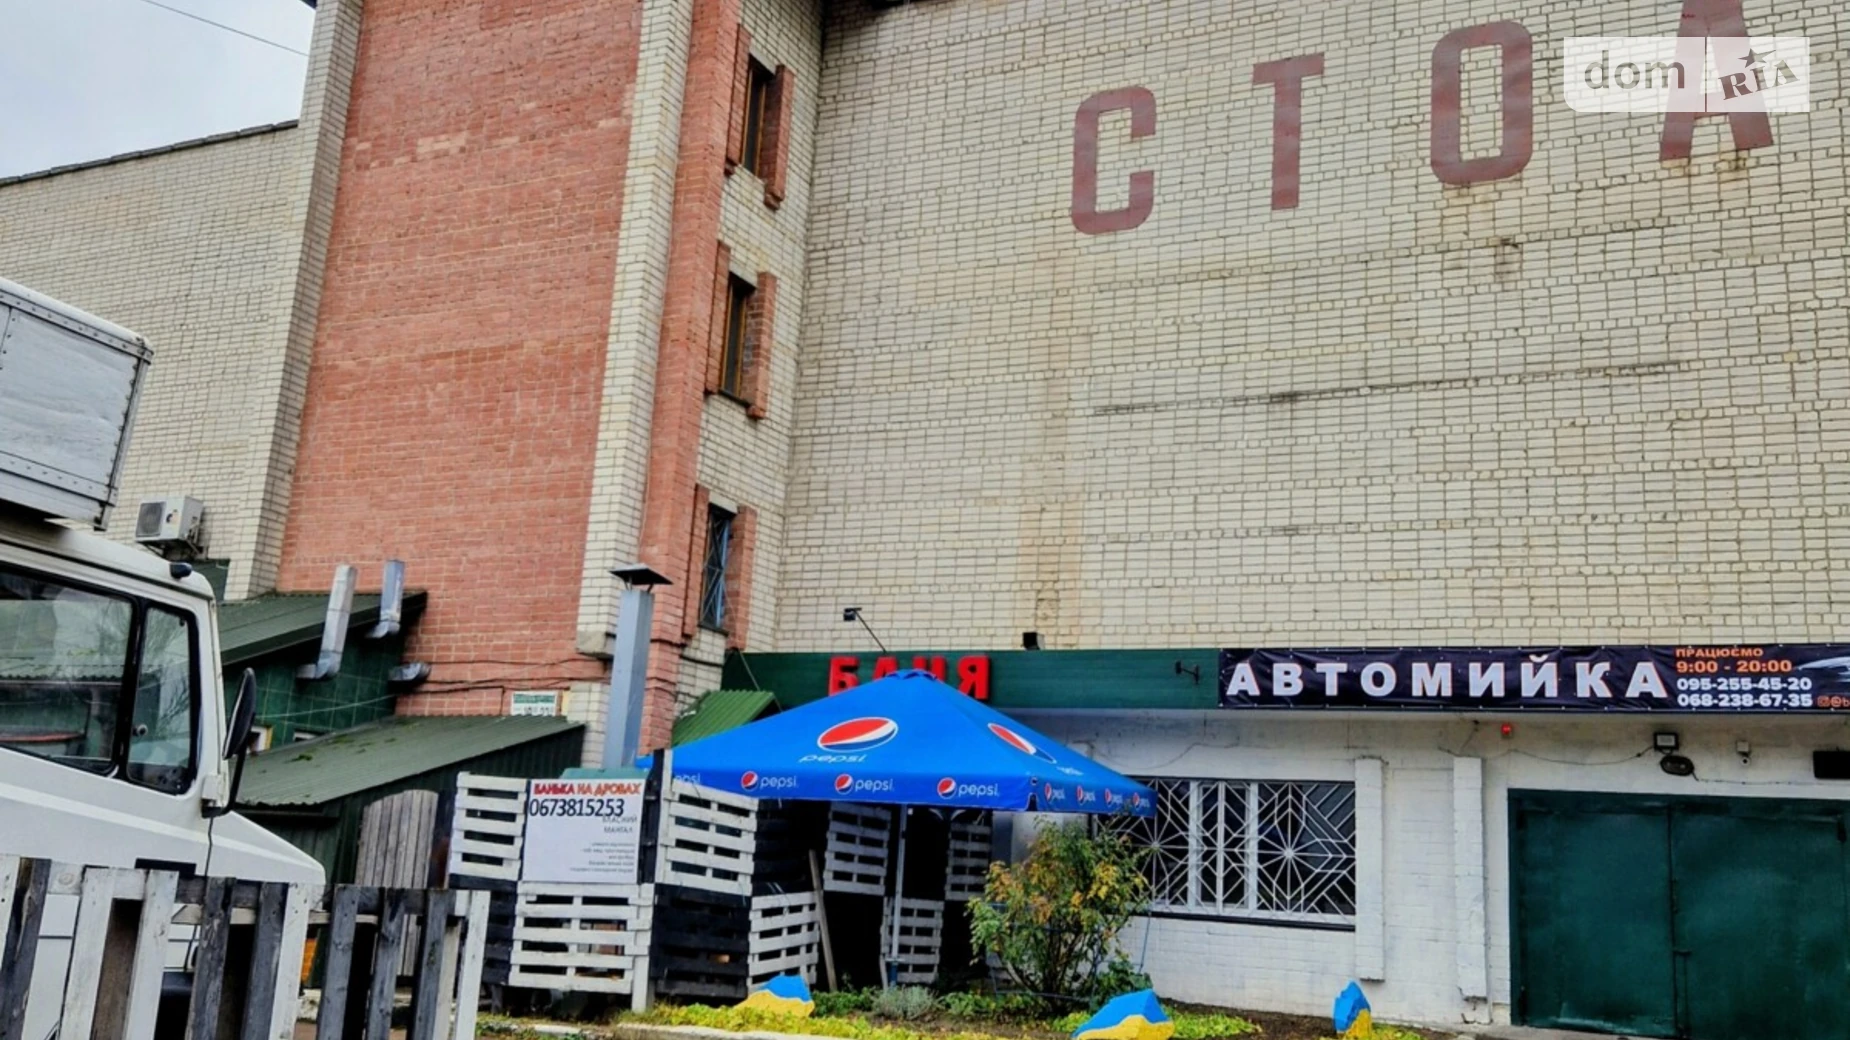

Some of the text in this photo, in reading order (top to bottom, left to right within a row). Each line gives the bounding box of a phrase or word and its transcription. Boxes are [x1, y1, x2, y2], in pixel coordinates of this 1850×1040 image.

[1676, 660, 1718, 673] 9:00
[1736, 660, 1792, 673] 20:00
[1226, 654, 1668, 698] АВТОМИЙКА
[1676, 677, 1812, 691] 095-255-45-20
[1677, 693, 1813, 707] 068-238-67-35
[799, 754, 868, 764] pepsi
[534, 783, 641, 797] БАНЬКА НА ДРОВАХ
[760, 776, 797, 790] pepsi
[854, 779, 894, 794] pepsi
[958, 783, 999, 798] pepsi
[529, 799, 625, 817] 0673815253
